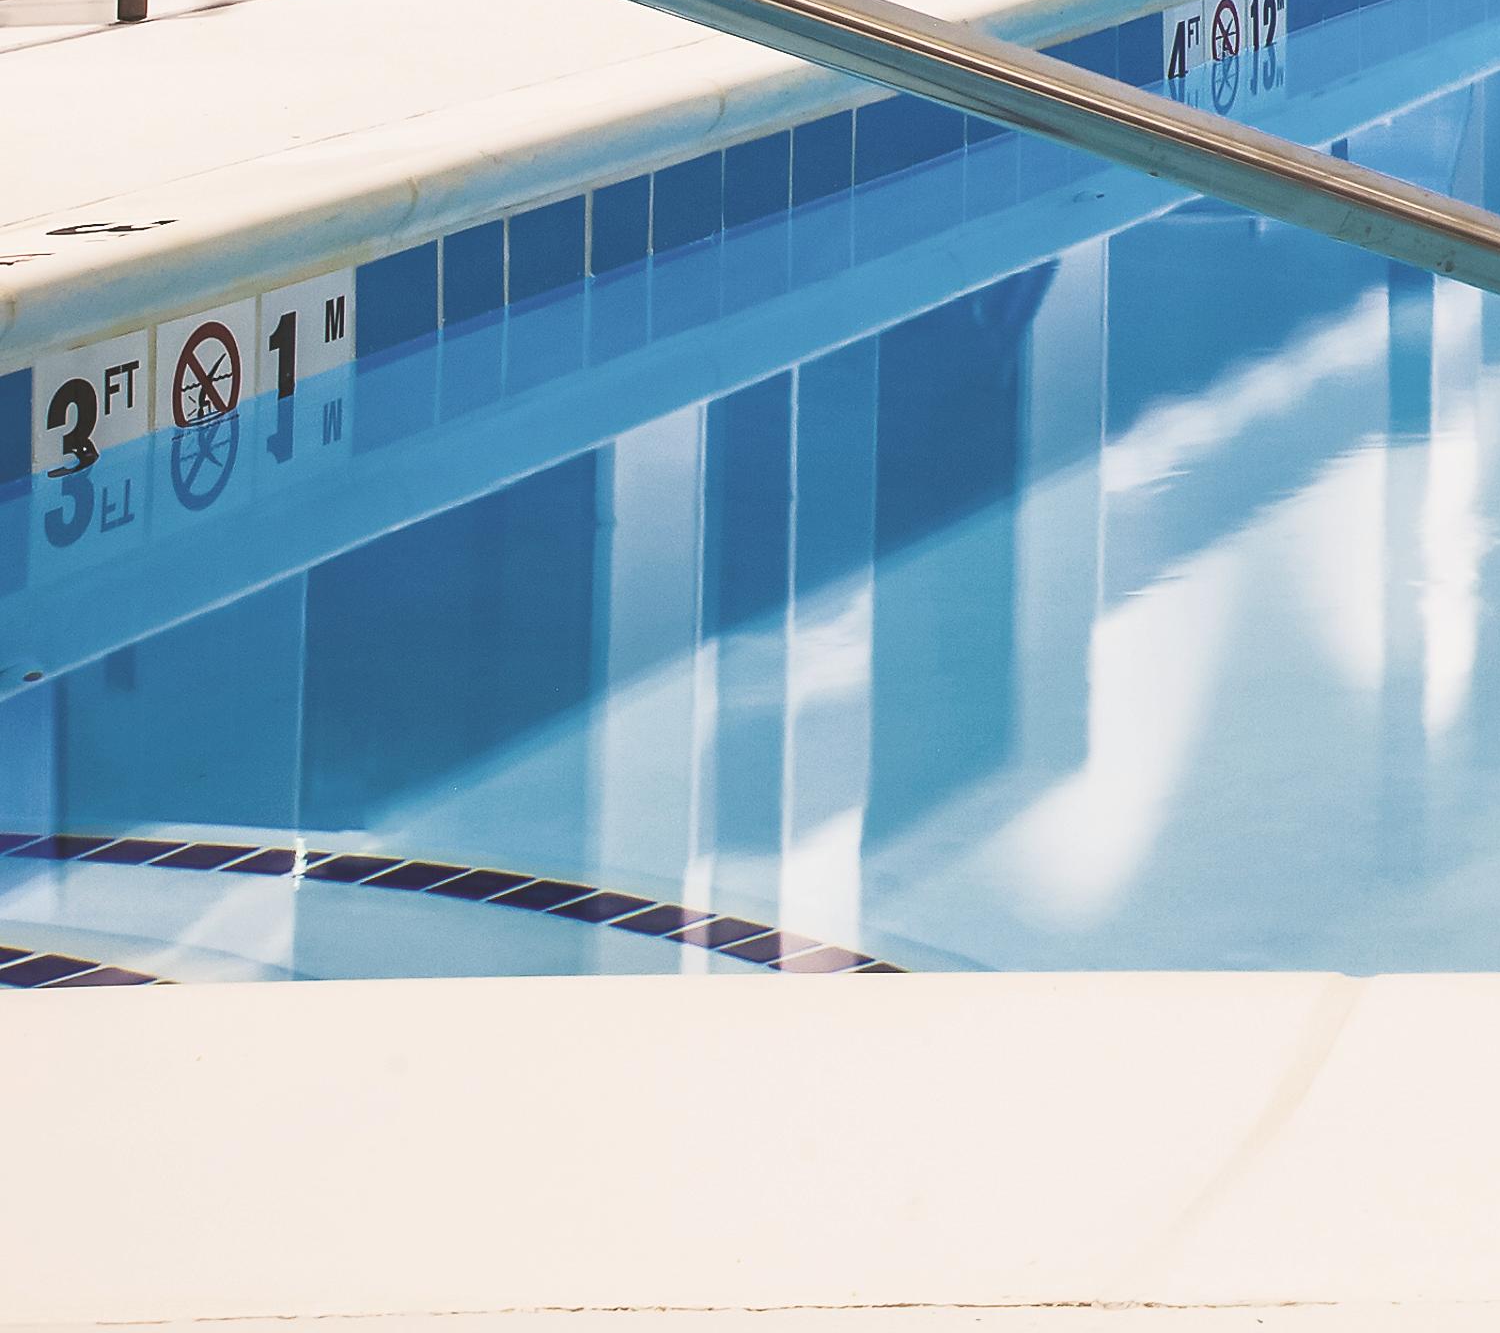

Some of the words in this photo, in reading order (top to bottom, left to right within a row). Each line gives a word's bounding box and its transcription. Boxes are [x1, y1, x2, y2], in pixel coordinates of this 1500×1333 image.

[1188, 15, 1200, 49] FT
[269, 311, 297, 399] 1
[324, 295, 346, 344] M
[46, 378, 100, 478] 3
[104, 360, 140, 416] FT
